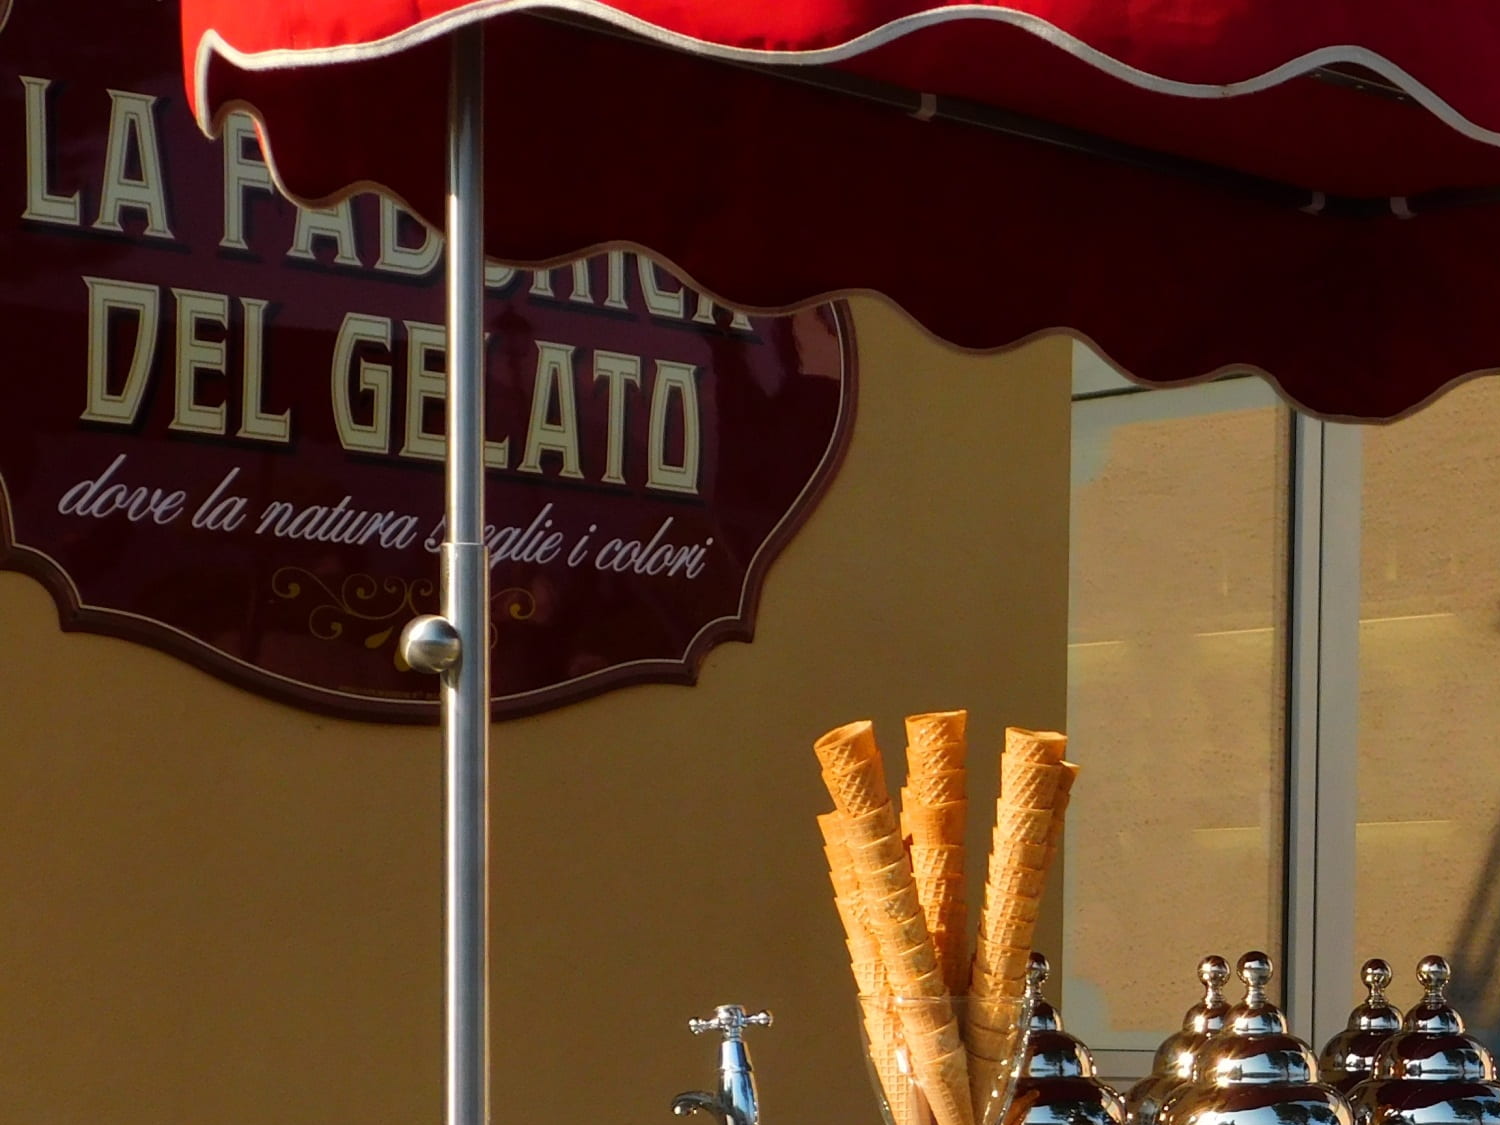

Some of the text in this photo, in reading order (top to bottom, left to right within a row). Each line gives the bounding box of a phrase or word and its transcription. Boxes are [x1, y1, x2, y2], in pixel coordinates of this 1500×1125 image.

[19, 75, 174, 239] LA
[80, 275, 700, 495] DEL GEATO
[57, 453, 187, 525] dove
[191, 466, 249, 532] la
[255, 495, 418, 550] natura
[567, 524, 597, 568] i
[595, 516, 714, 579] colori
